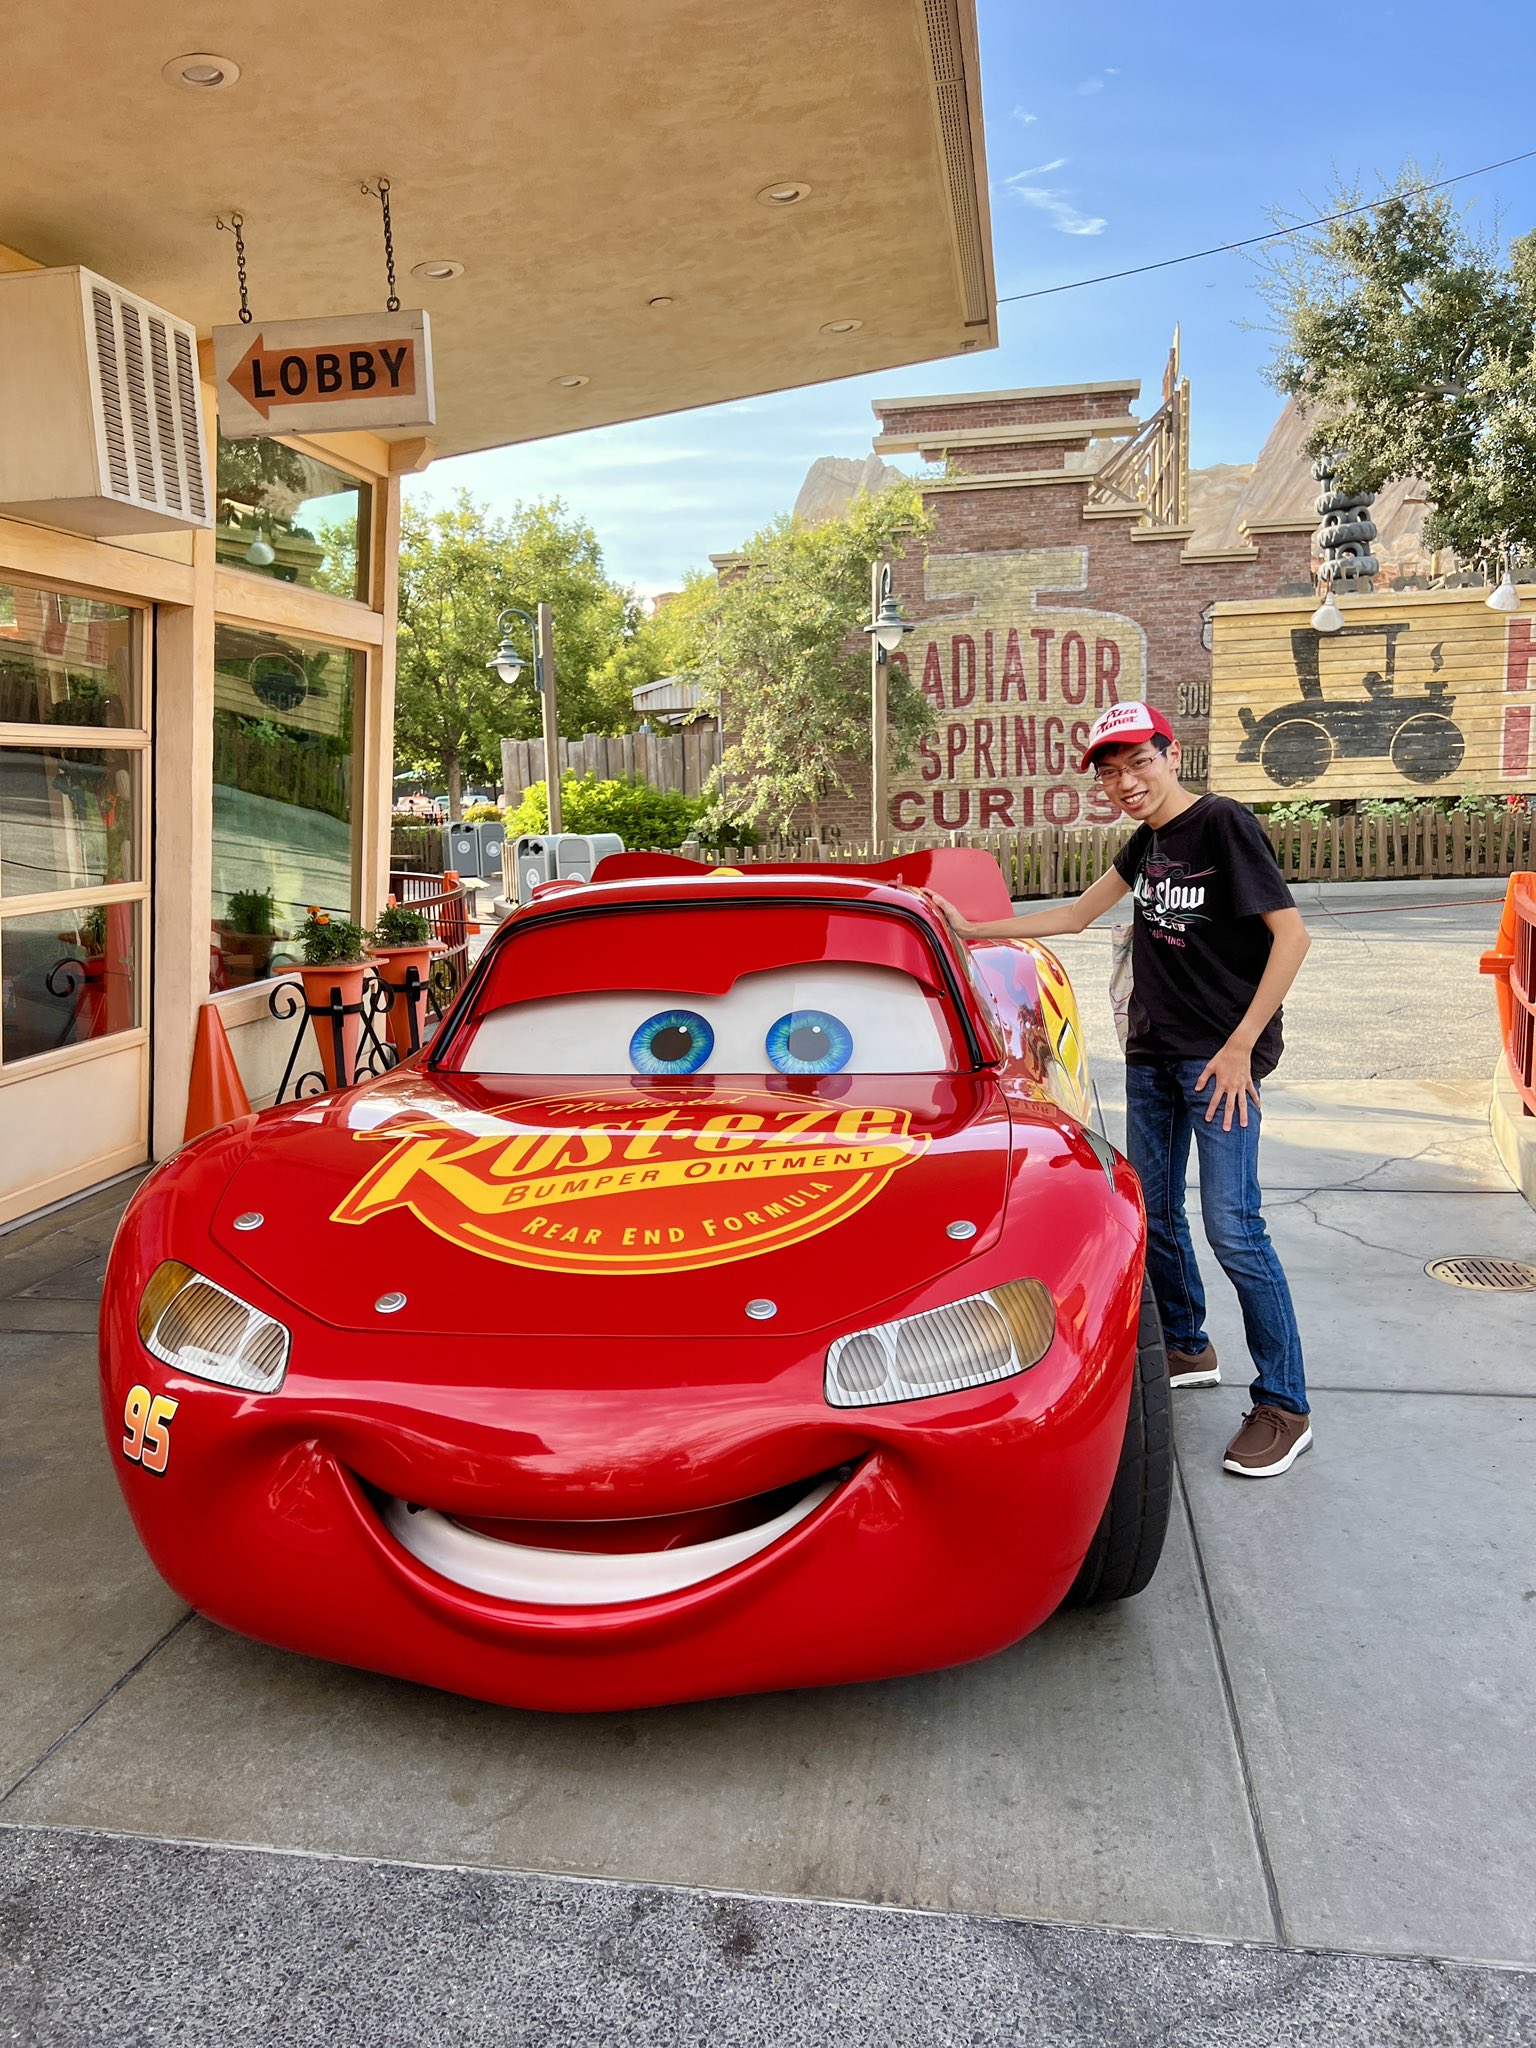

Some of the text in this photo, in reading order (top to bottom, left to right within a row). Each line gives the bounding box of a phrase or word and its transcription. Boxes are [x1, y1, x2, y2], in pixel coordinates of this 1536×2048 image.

[252, 347, 408, 398] LOBBY
[920, 715, 1092, 782] SPRINGS
[890, 784, 1122, 832] CURIOS
[1155, 878, 1205, 914] Slow
[545, 1095, 748, 1117] Medicated
[502, 1151, 875, 1206] BUMPER OINTMENT
[521, 1181, 834, 1246] REAR END FORMULA
[122, 1384, 179, 1476] 95
